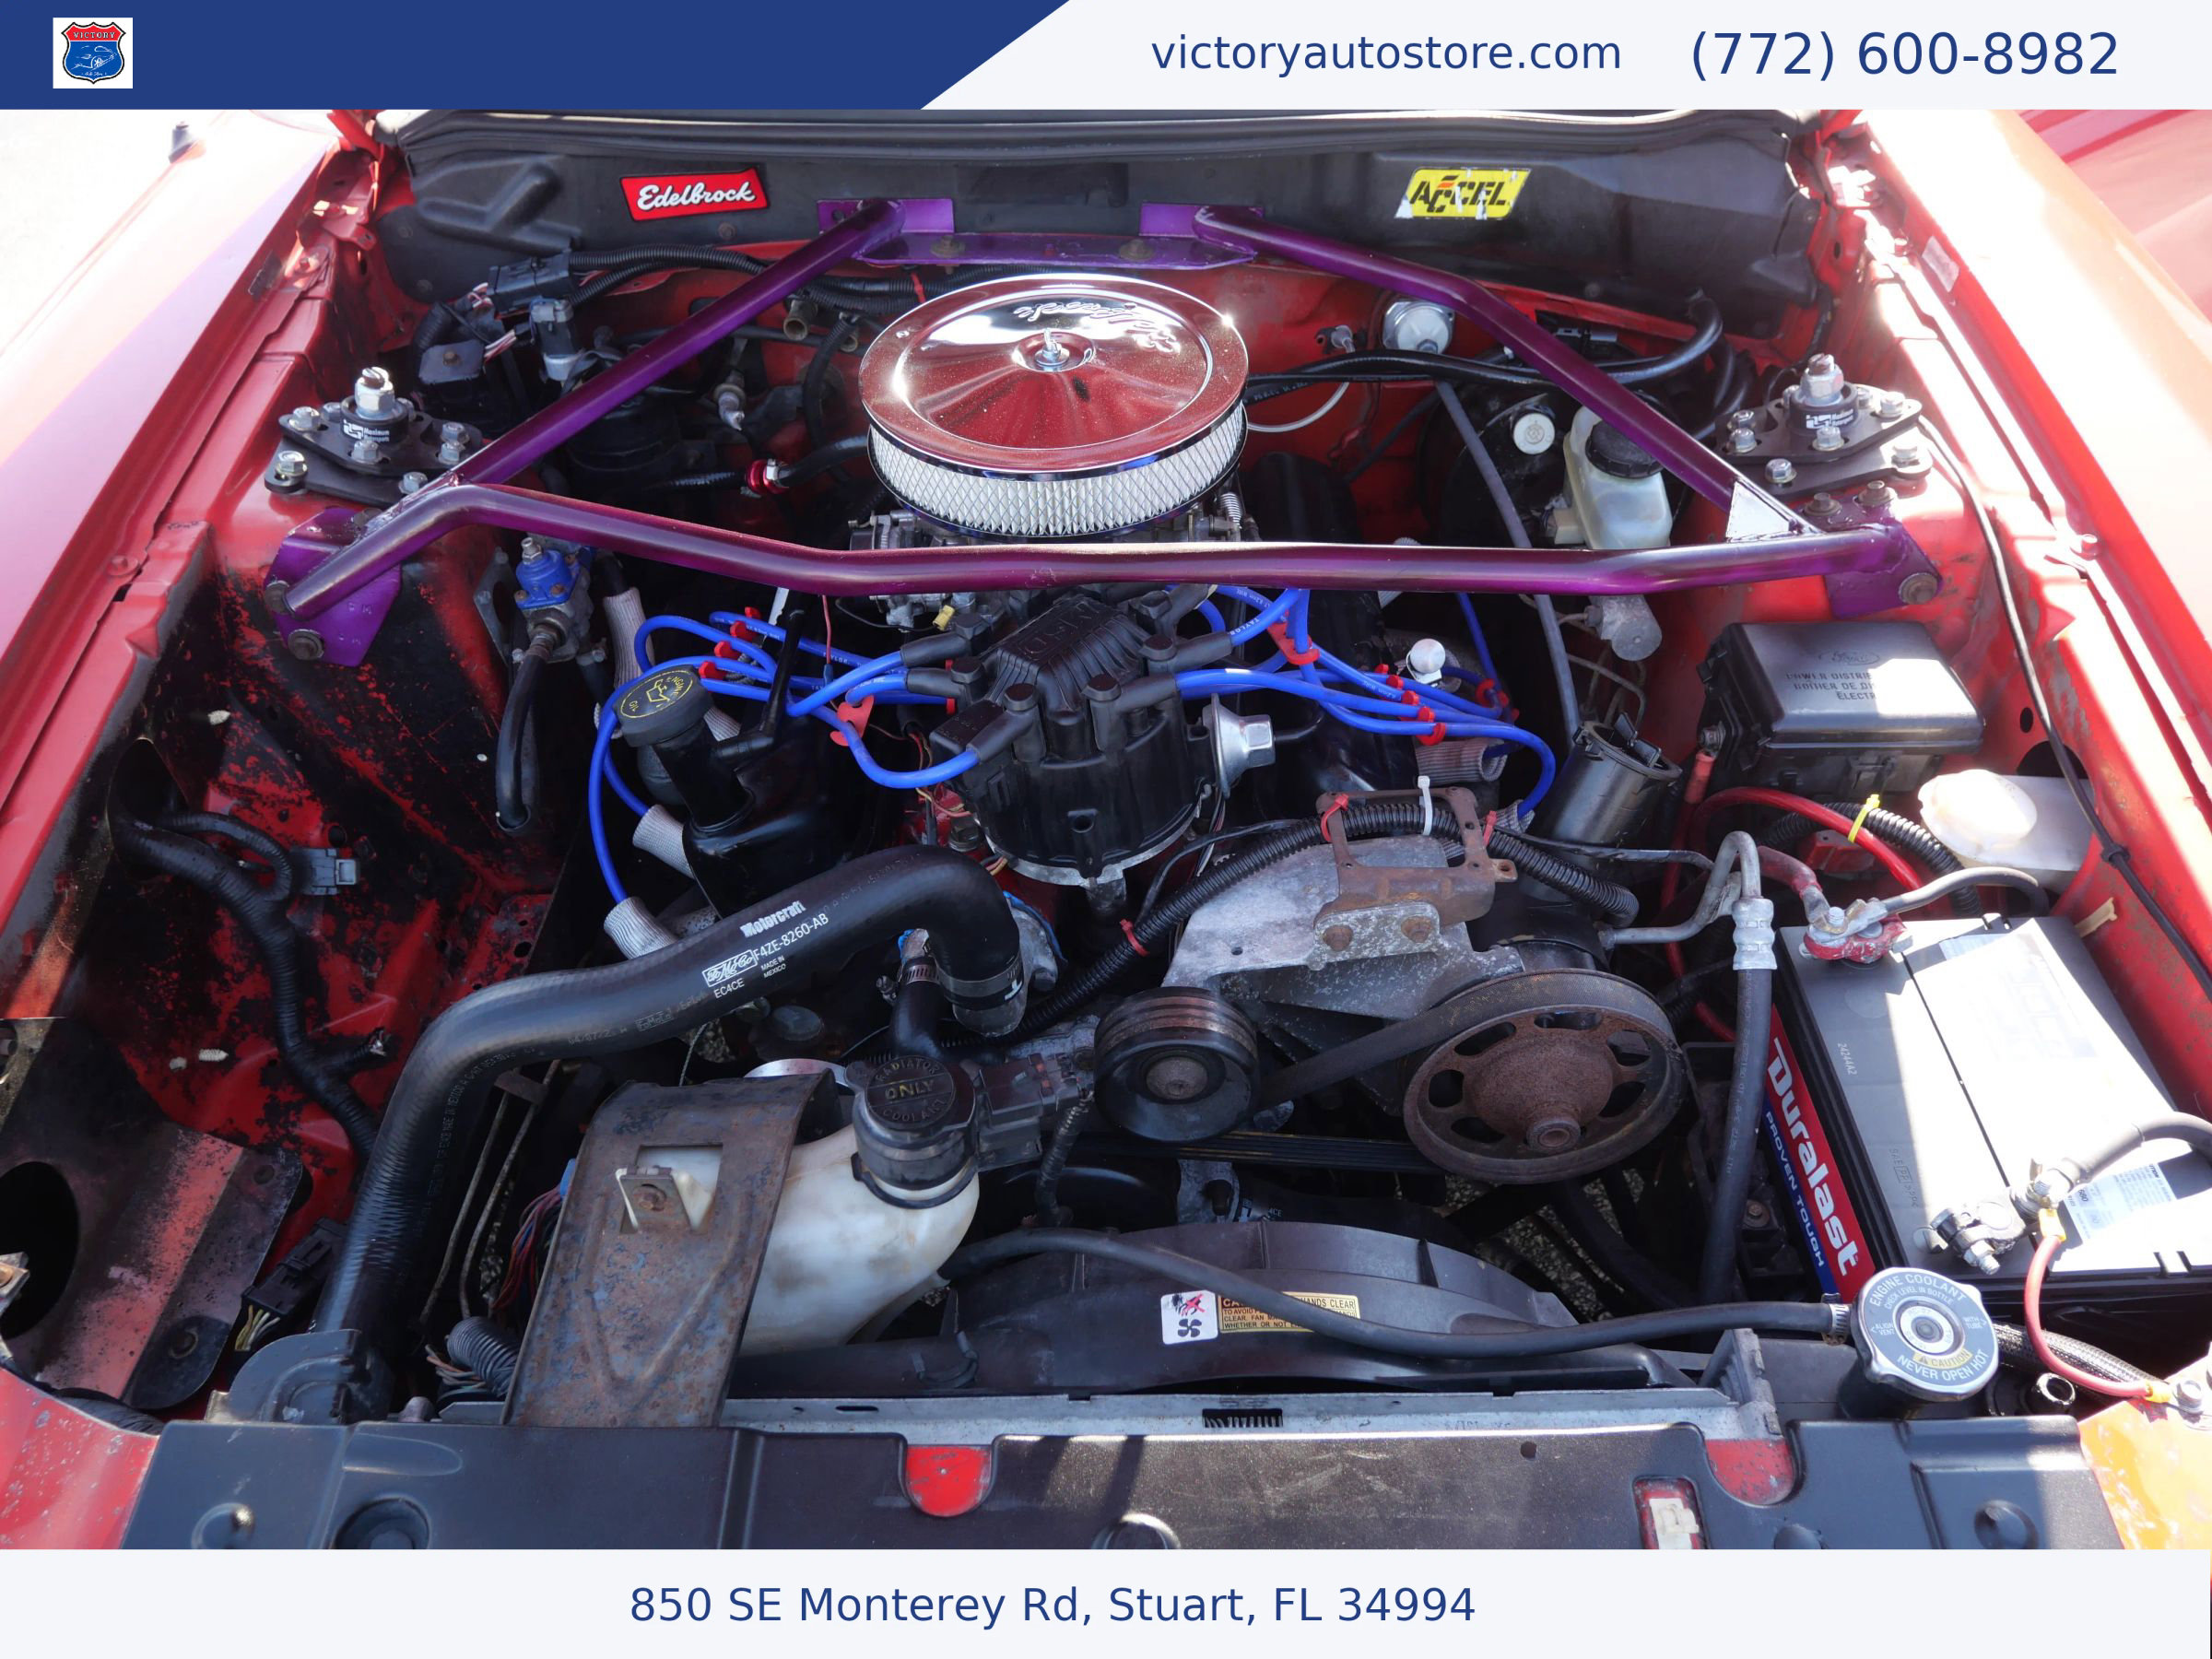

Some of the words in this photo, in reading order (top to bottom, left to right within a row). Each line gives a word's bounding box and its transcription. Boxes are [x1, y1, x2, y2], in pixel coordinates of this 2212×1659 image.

[637, 182, 756, 211] Edelbrock
[1409, 175, 1506, 213] ACCEL
[740, 900, 806, 938] Motorcraft
[753, 912, 830, 960] F4ZE-8260-AB
[760, 959, 780, 971] MADE
[779, 955, 785, 964] IN
[763, 963, 787, 979] MEXICO
[713, 978, 746, 999] EC4CE
[875, 1058, 940, 1082] RADIATOR
[885, 1079, 935, 1100] ONLY
[1768, 1038, 1859, 1277] Duralast
[1765, 1111, 1797, 1191] PROVEN
[1796, 1194, 1825, 1268] TOUGH
[1869, 1276, 1904, 1307] ENGINE
[1905, 1274, 1967, 1302] COOLANT
[1898, 1287, 1918, 1298] LEVEL
[1927, 1288, 1954, 1305] BOTTLE
[1330, 1299, 1355, 1310] CLEAR
[1224, 1321, 1258, 1329] WHETHER
[1897, 1355, 1939, 1380] NEVER
[1941, 1365, 1974, 1382] OPEN
[1970, 1348, 1989, 1371] HOT
[1931, 1349, 1971, 1368] CAUTION
